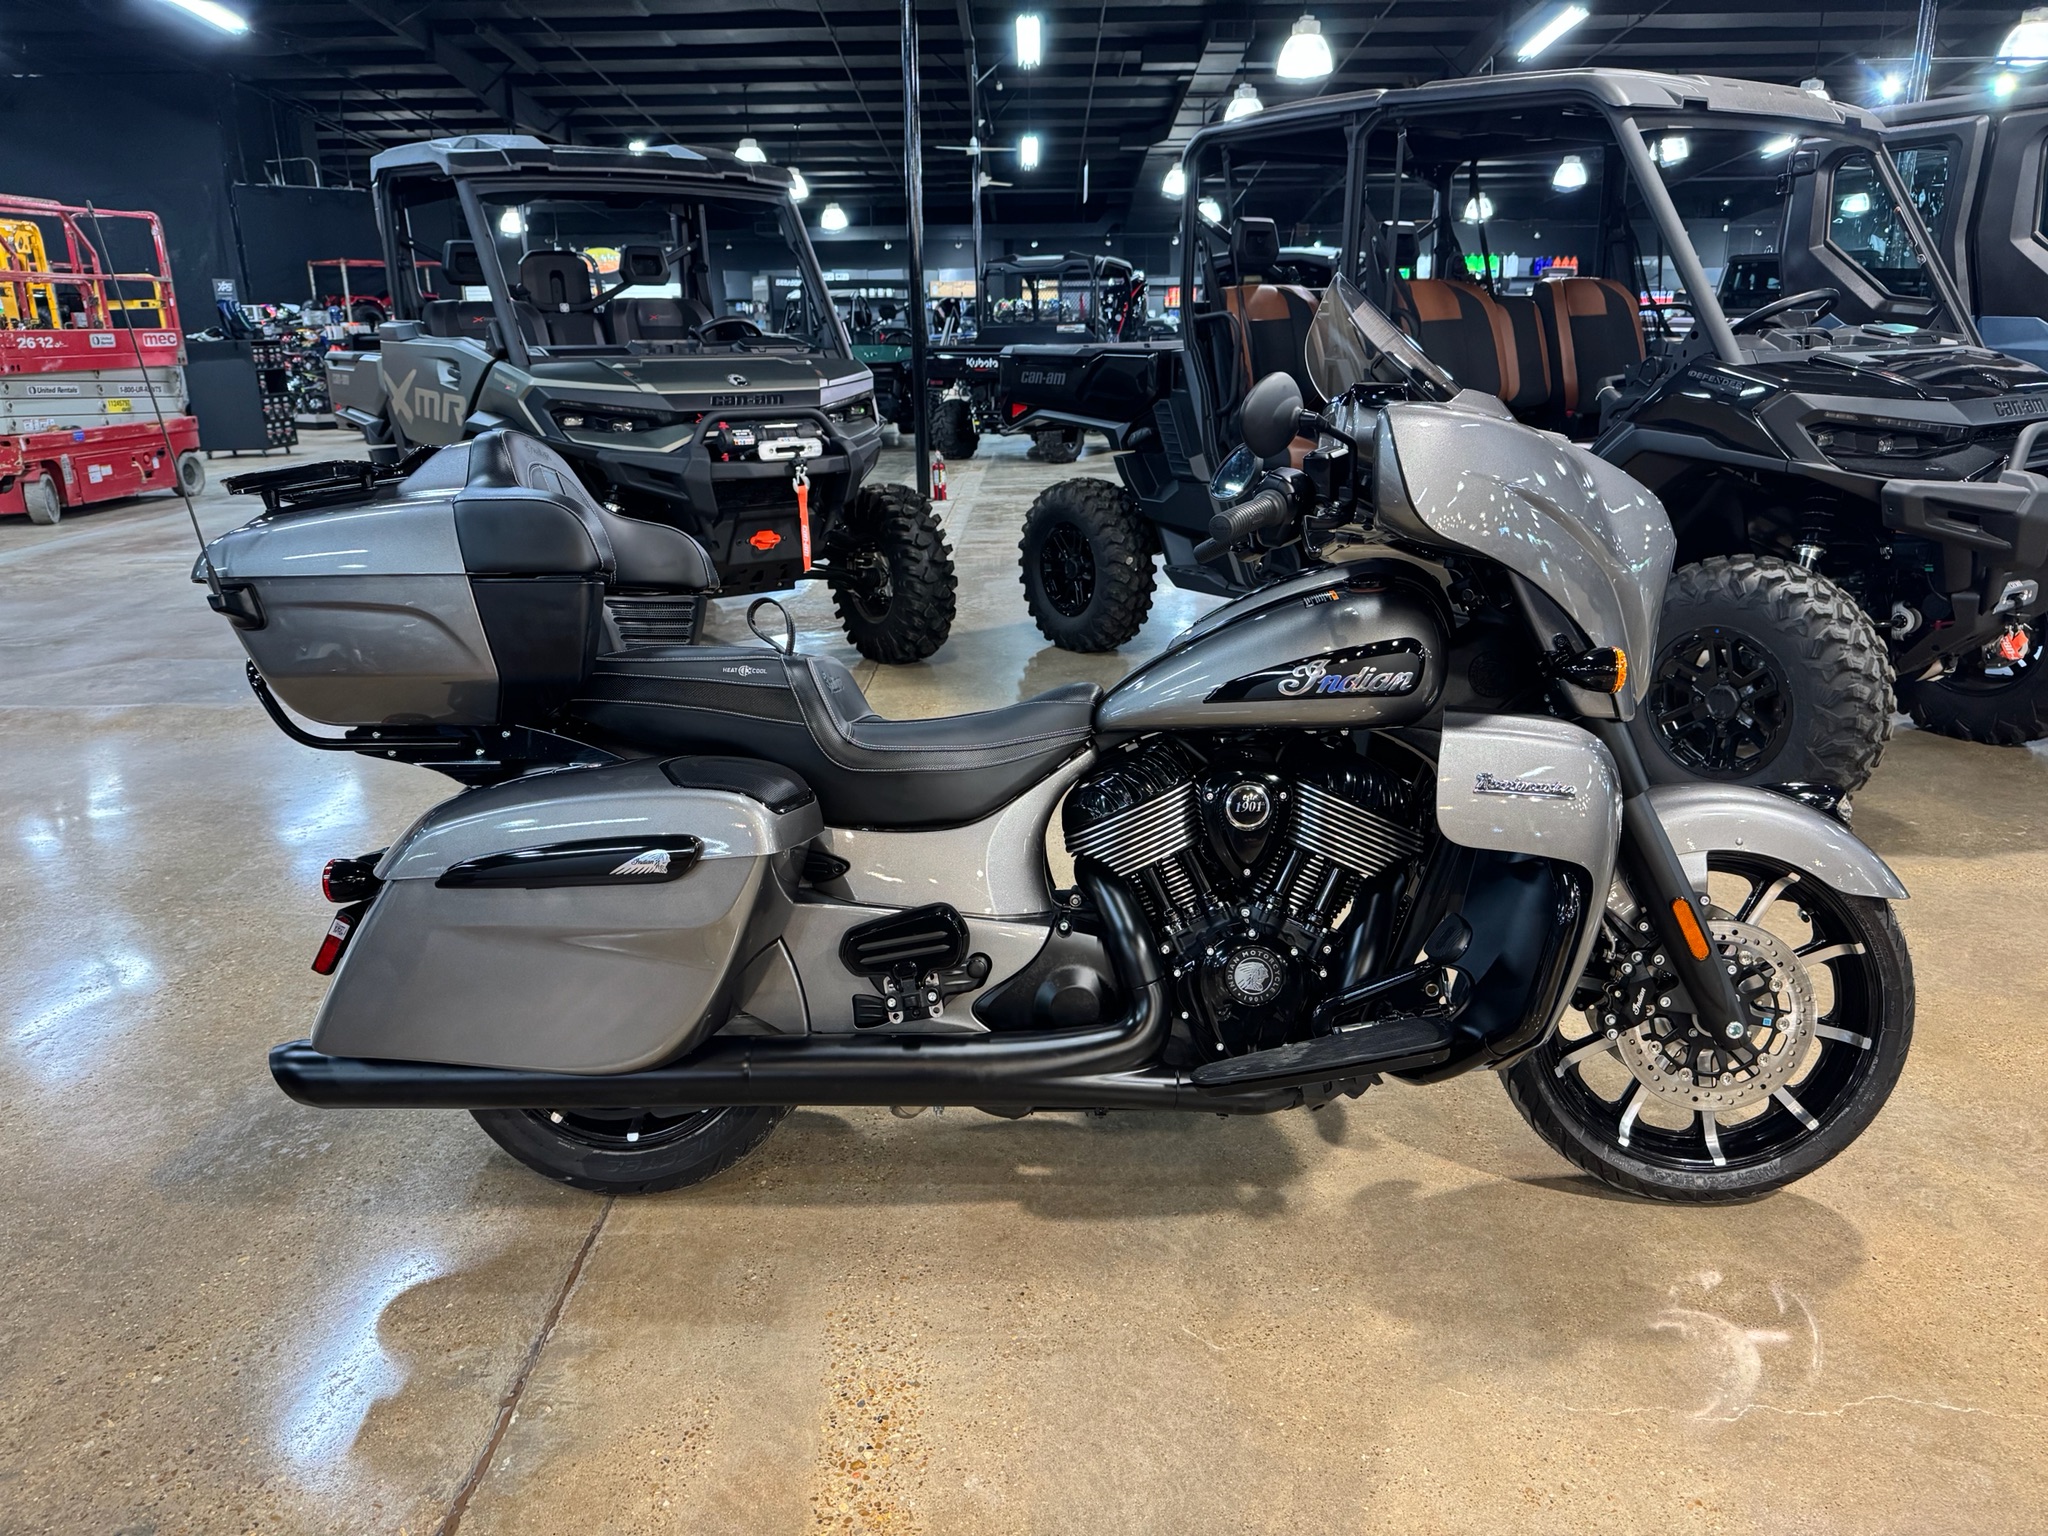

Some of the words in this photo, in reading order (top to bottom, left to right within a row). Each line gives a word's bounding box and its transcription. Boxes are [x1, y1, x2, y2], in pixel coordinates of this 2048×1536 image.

[217, 281, 233, 292] XPS
[144, 334, 176, 345] mec
[966, 357, 999, 369] Kubota
[1020, 371, 1066, 386] can-am
[37, 386, 57, 394] United
[57, 386, 78, 394] Rentals
[710, 394, 784, 406] can-am
[1993, 397, 2048, 416] can-am
[1277, 659, 1414, 696] Indian
[1235, 801, 1262, 813] 1901
[1241, 950, 1281, 993] MOTORCYCLE
[1632, 987, 1647, 1016] Indian
